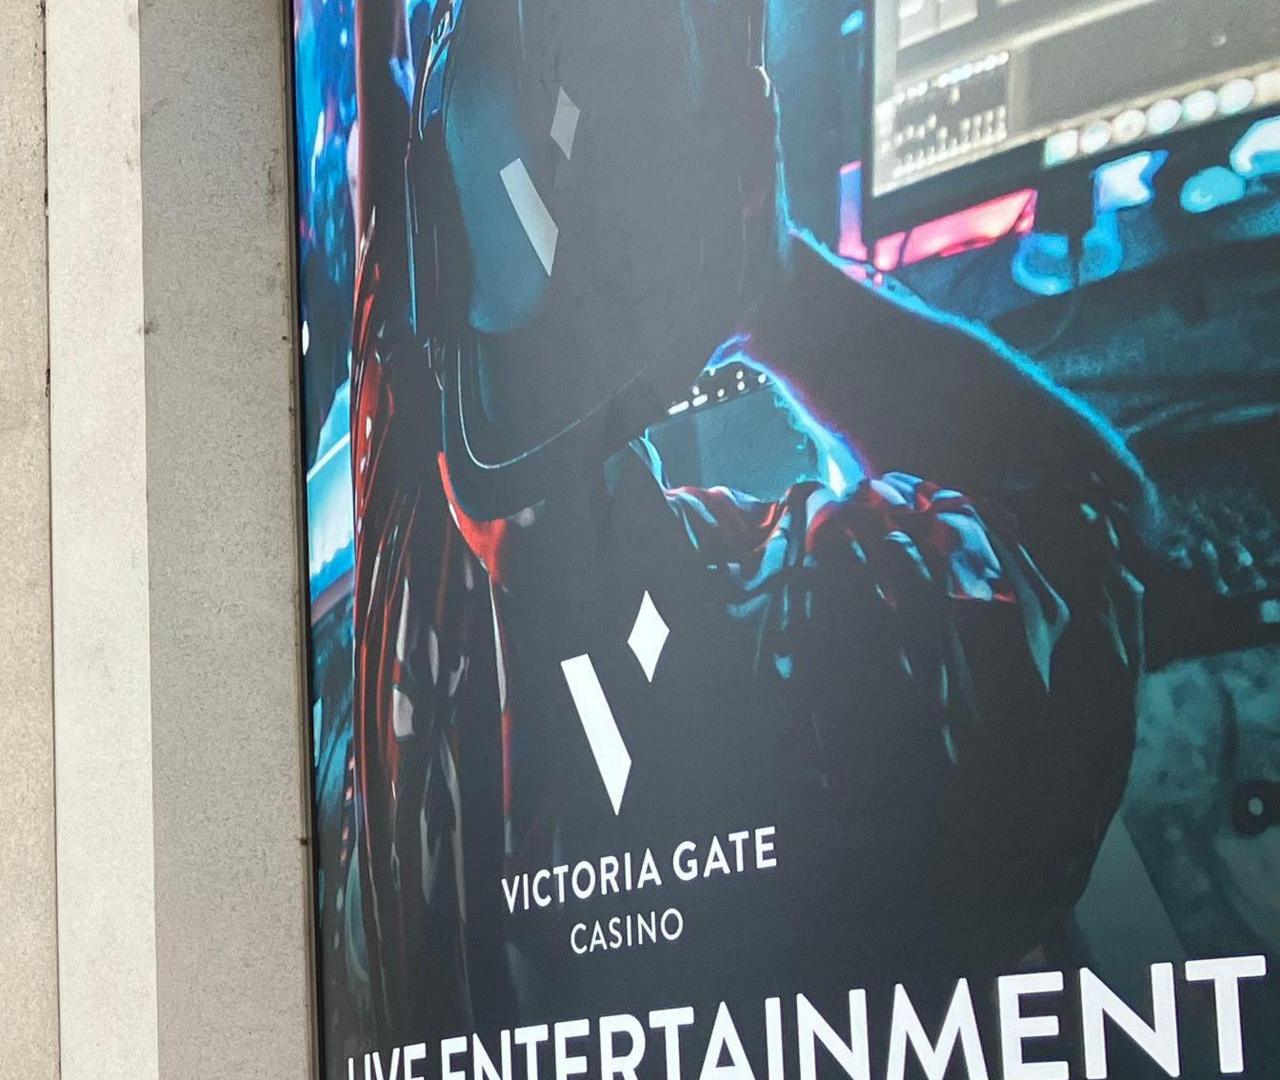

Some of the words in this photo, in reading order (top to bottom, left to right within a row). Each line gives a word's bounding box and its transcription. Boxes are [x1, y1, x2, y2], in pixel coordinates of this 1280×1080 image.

[501, 849, 663, 914] VICTORIA
[672, 826, 778, 882] GATE
[570, 908, 684, 955] CASINO
